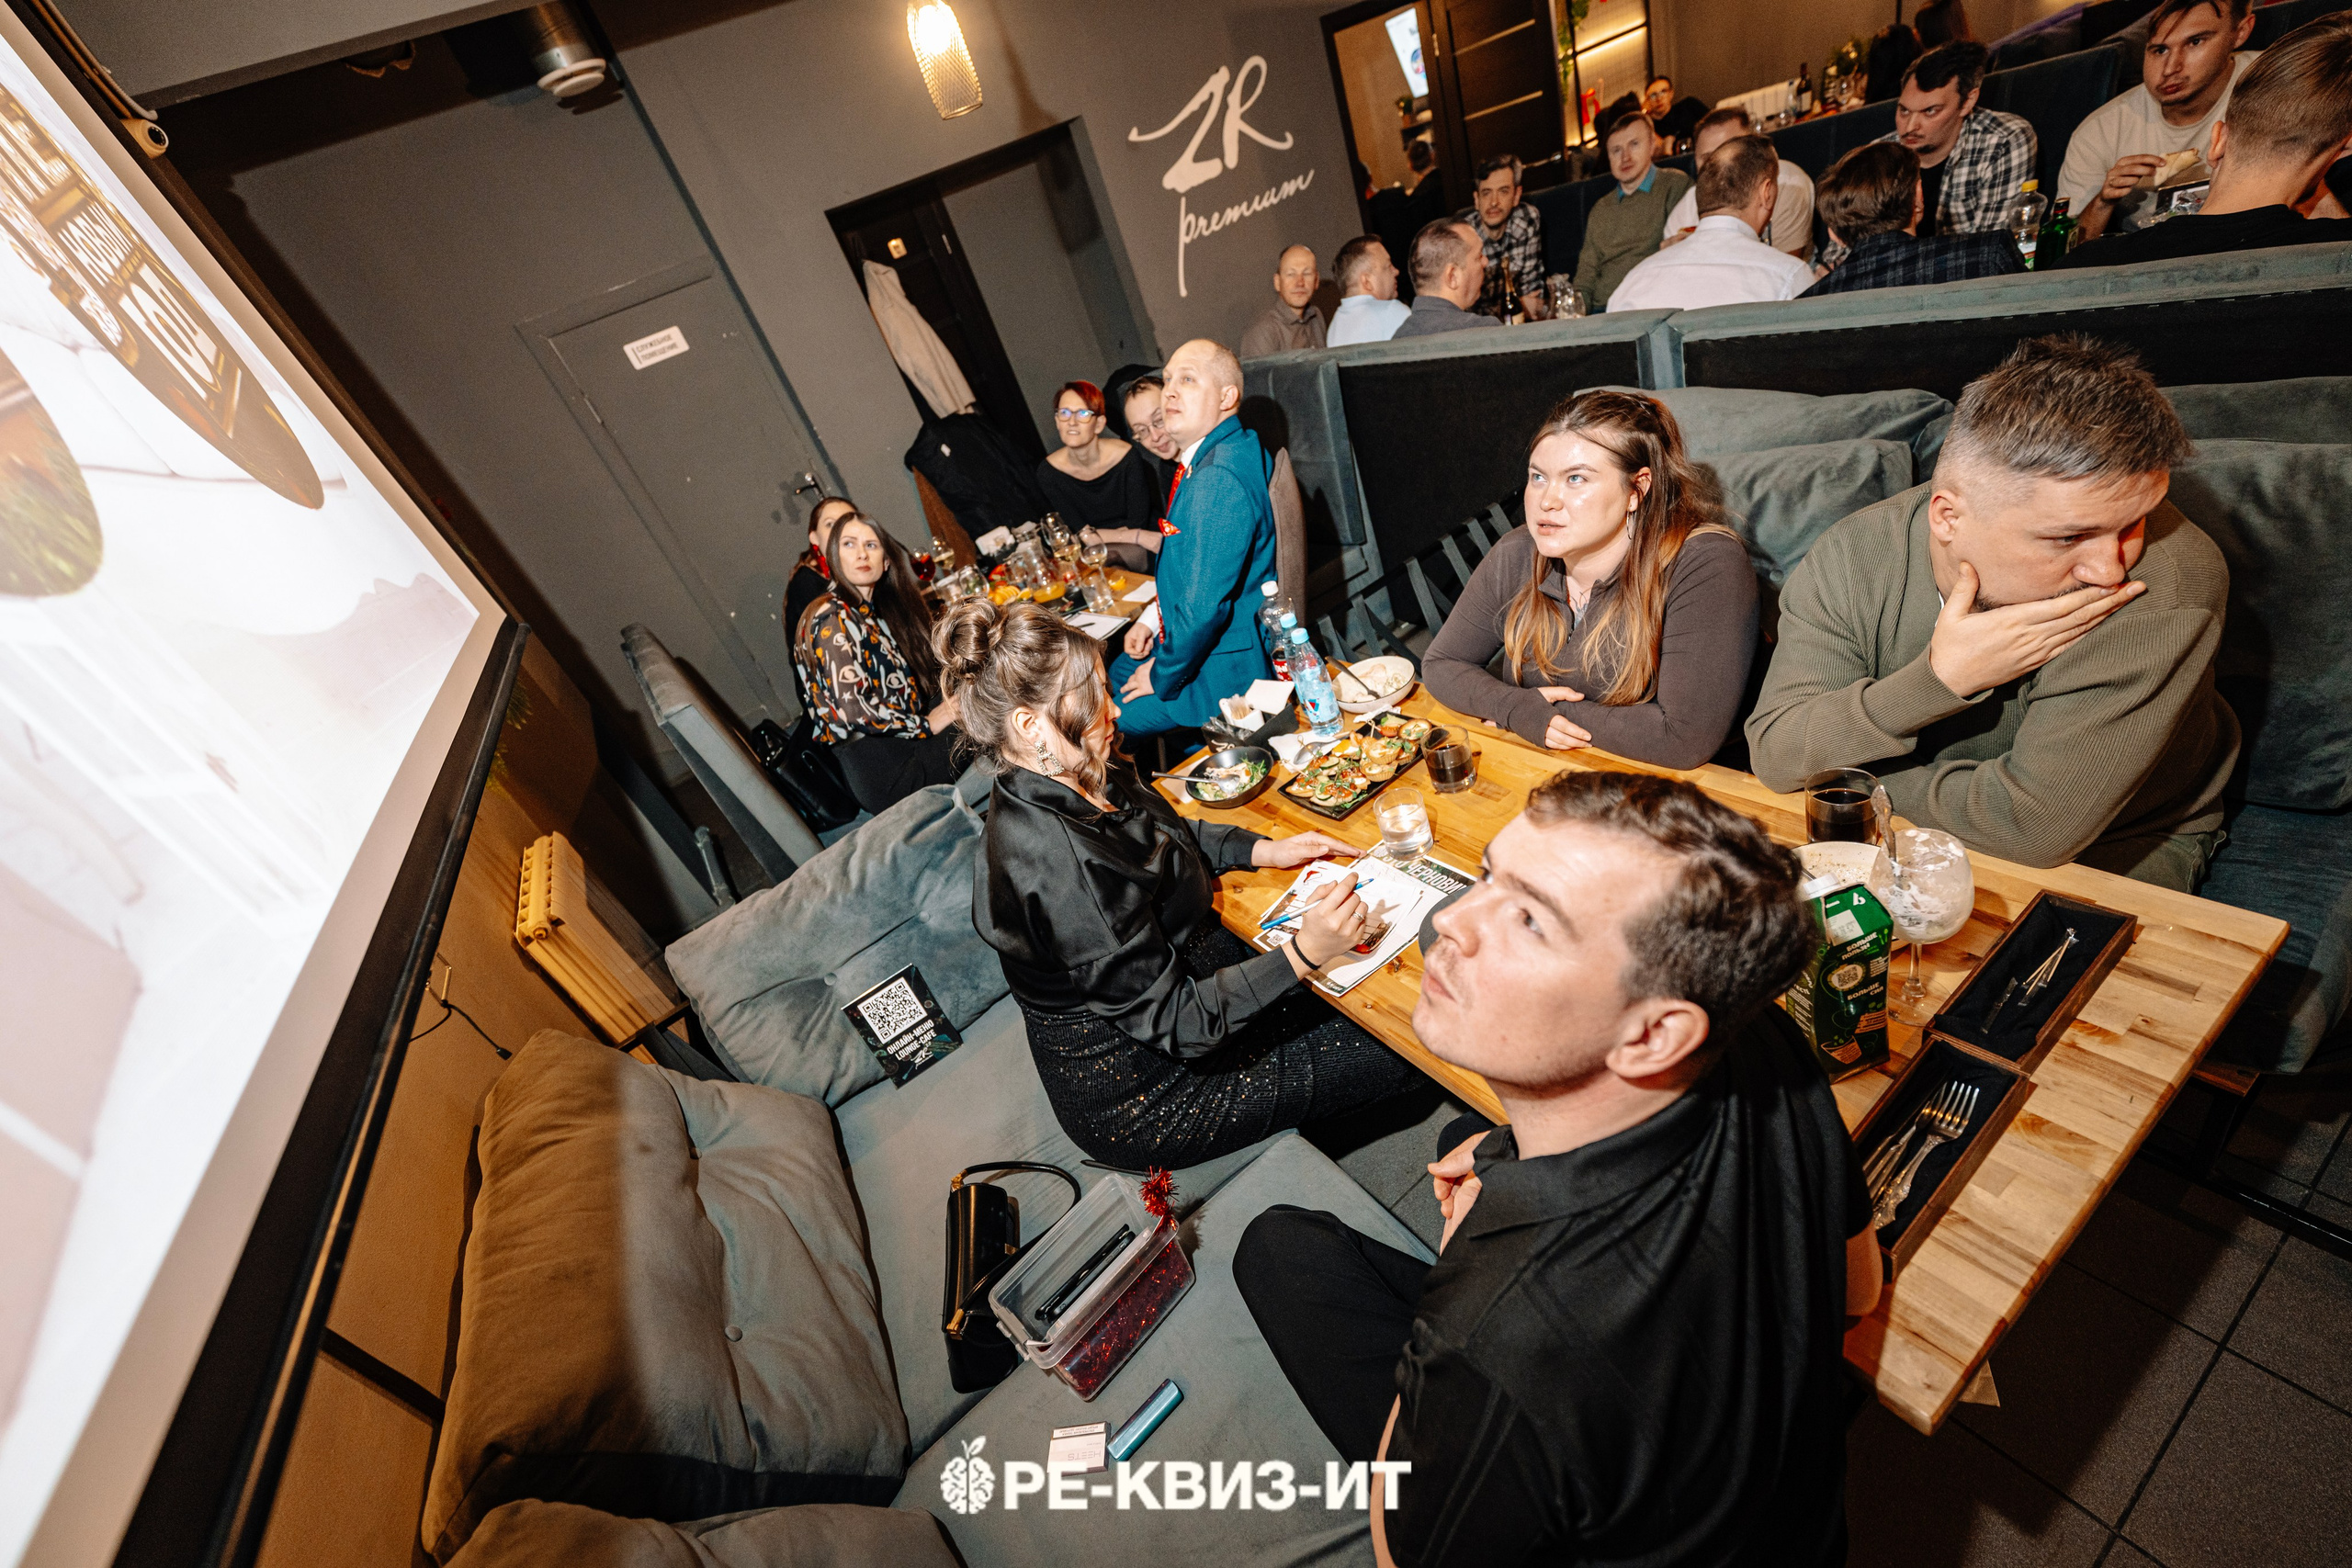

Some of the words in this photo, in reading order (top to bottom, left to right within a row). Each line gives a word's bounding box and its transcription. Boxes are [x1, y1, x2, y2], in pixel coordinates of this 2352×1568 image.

[1128, 55, 1294, 194] ZR
[118, 262, 218, 401] ГОД
[1846, 931, 1878, 953] БОЛЬШЕ
[1847, 981, 1880, 1001] БОЛЬШЕ
[1870, 986, 1884, 996] СИЛ
[887, 1019, 934, 1055] ОНЛАЙН-МЕНЮ
[895, 1029, 937, 1061] LOUNGE-CAFE
[1068, 1450, 1102, 1461] HEETS
